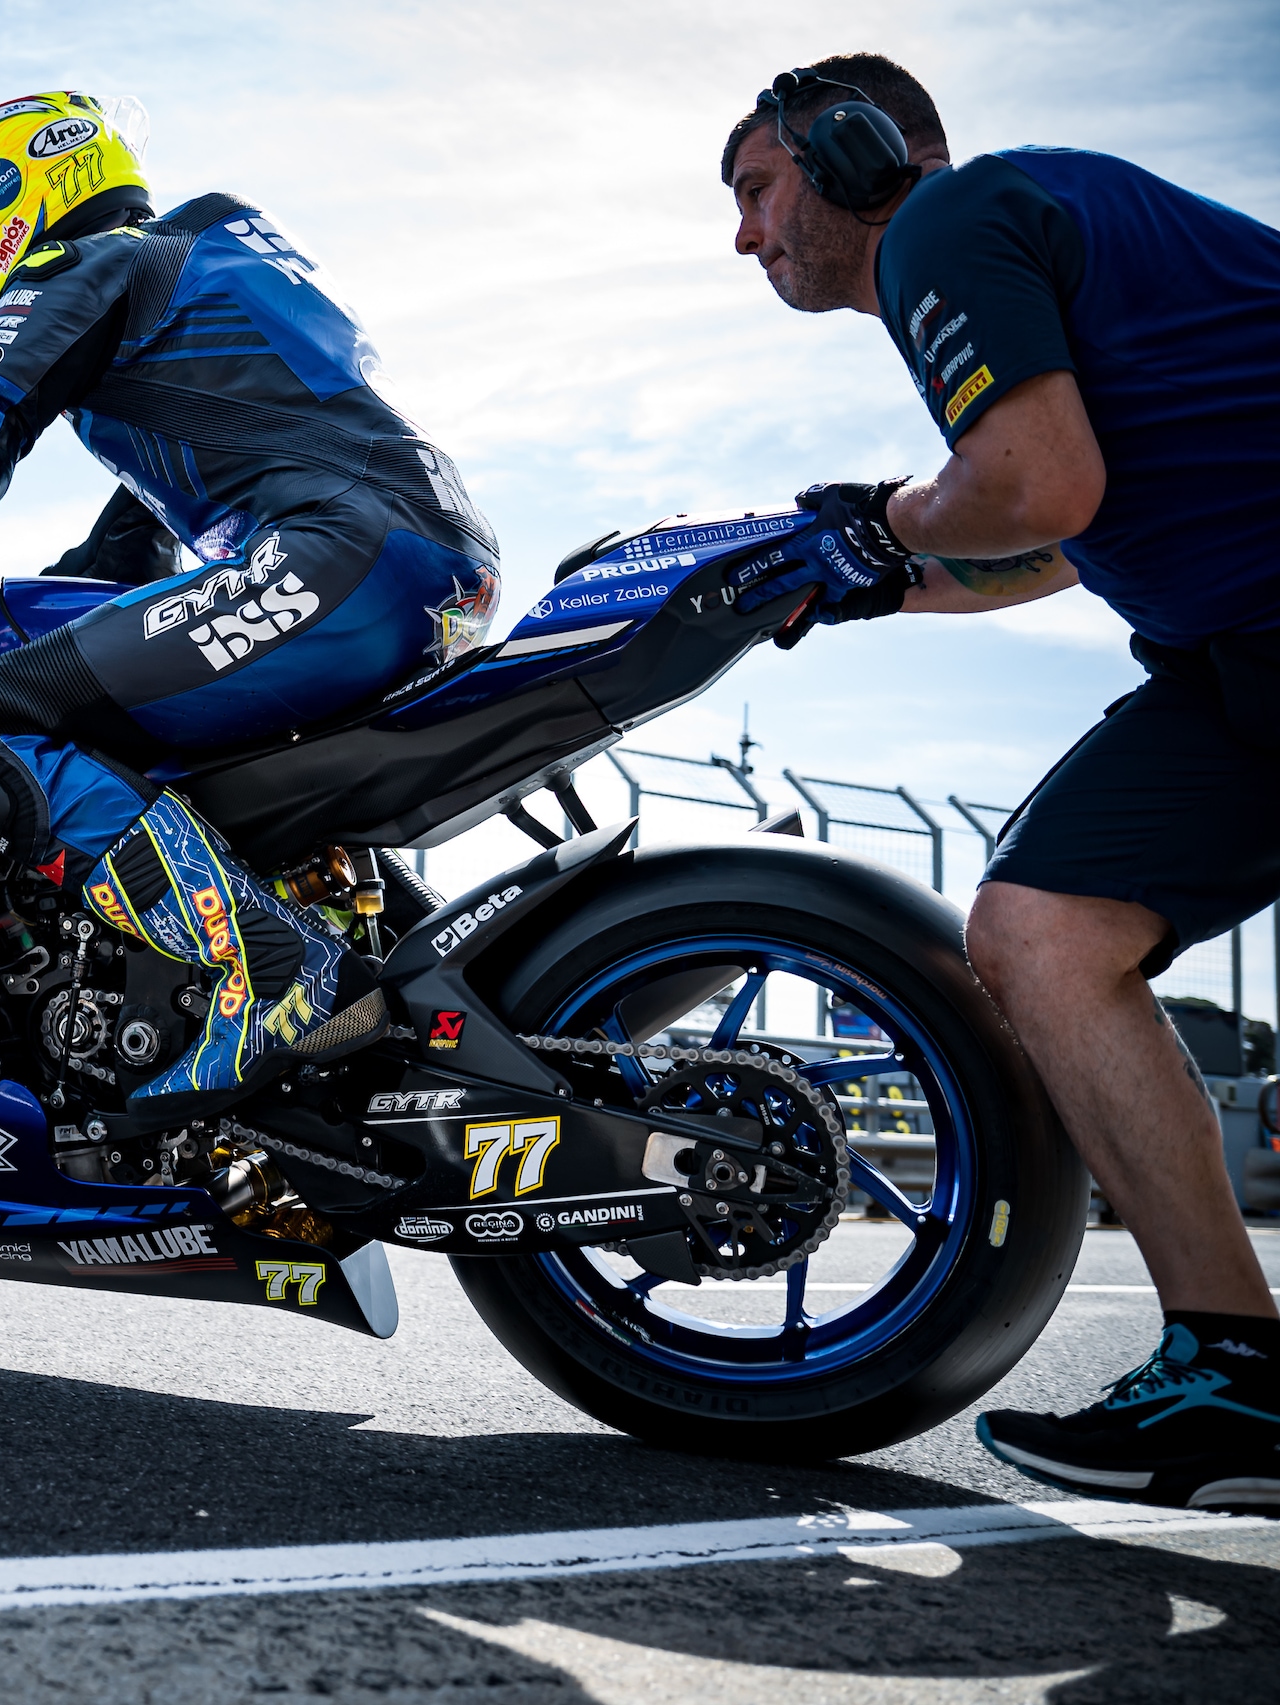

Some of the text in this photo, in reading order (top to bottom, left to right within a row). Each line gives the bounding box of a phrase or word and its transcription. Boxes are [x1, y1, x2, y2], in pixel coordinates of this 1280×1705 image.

[37, 118, 91, 157] Arai
[45, 142, 106, 209] 77
[947, 371, 988, 422] PIRELLI
[144, 533, 289, 640] GYTR
[831, 549, 874, 587] YAMAHA
[559, 583, 669, 611] Keller Zable
[451, 885, 523, 940] Beta
[263, 982, 314, 1046] 77
[367, 1089, 466, 1113] GYTR
[464, 1115, 560, 1200] 77
[399, 1217, 450, 1236] domino
[557, 1205, 636, 1225] GANDINI
[58, 1224, 218, 1265] YAMALUBE
[255, 1260, 326, 1306] 77
